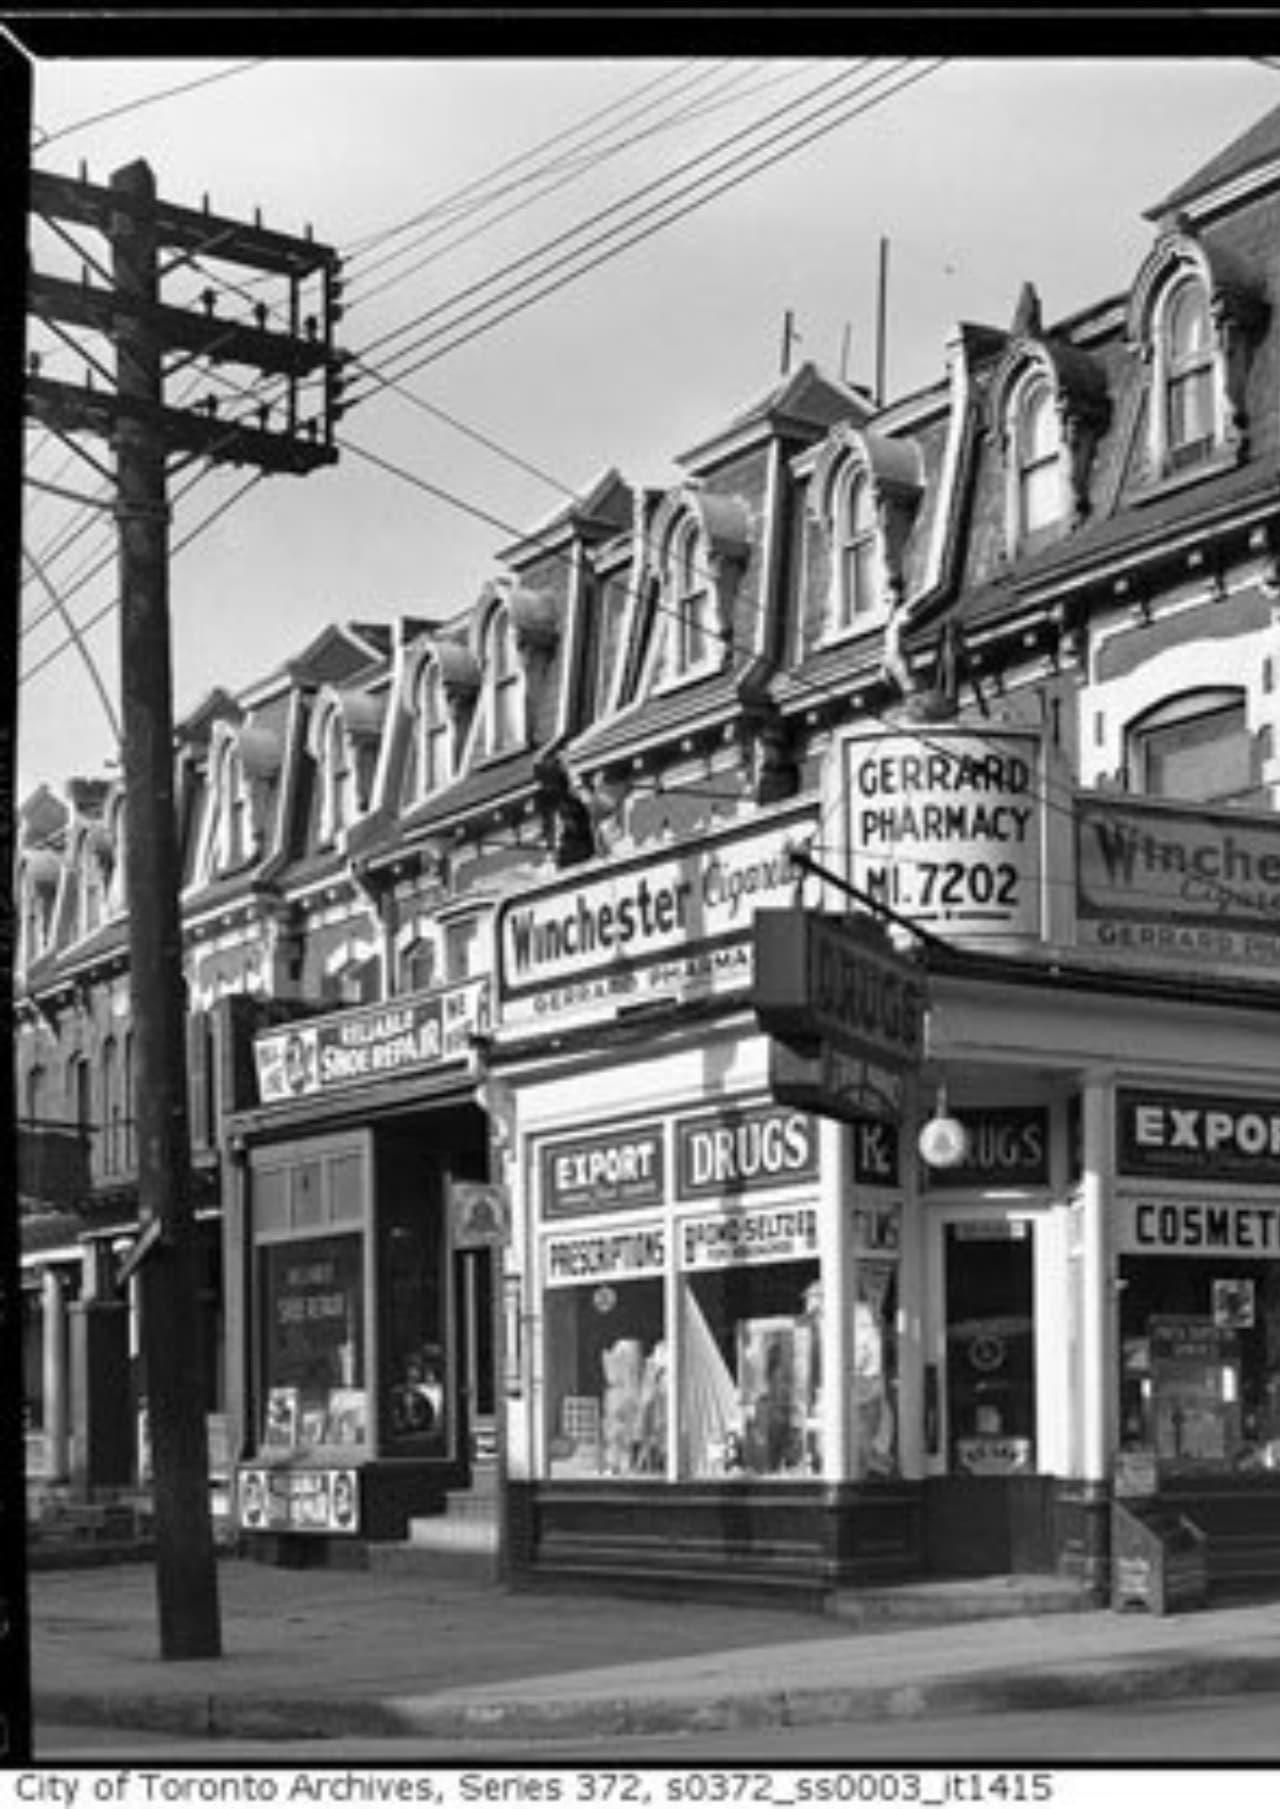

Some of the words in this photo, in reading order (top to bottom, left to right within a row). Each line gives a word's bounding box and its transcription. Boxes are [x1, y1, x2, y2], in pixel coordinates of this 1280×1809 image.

[858, 755, 1030, 796] GERRARD
[861, 805, 1033, 846] PHARMACY
[510, 878, 691, 976] Winchester
[1097, 923, 1235, 955] GERRARD
[650, 948, 748, 988] PHARMA
[818, 937, 919, 1050] DRUGS
[322, 1044, 371, 1082] SHOE
[371, 1018, 440, 1070] REPAIR
[555, 1140, 655, 1191] EXPORT
[691, 1114, 810, 1185] DRUGS
[964, 1122, 1042, 1168] UGS
[550, 1230, 665, 1277] PRESCRIPTIONS
